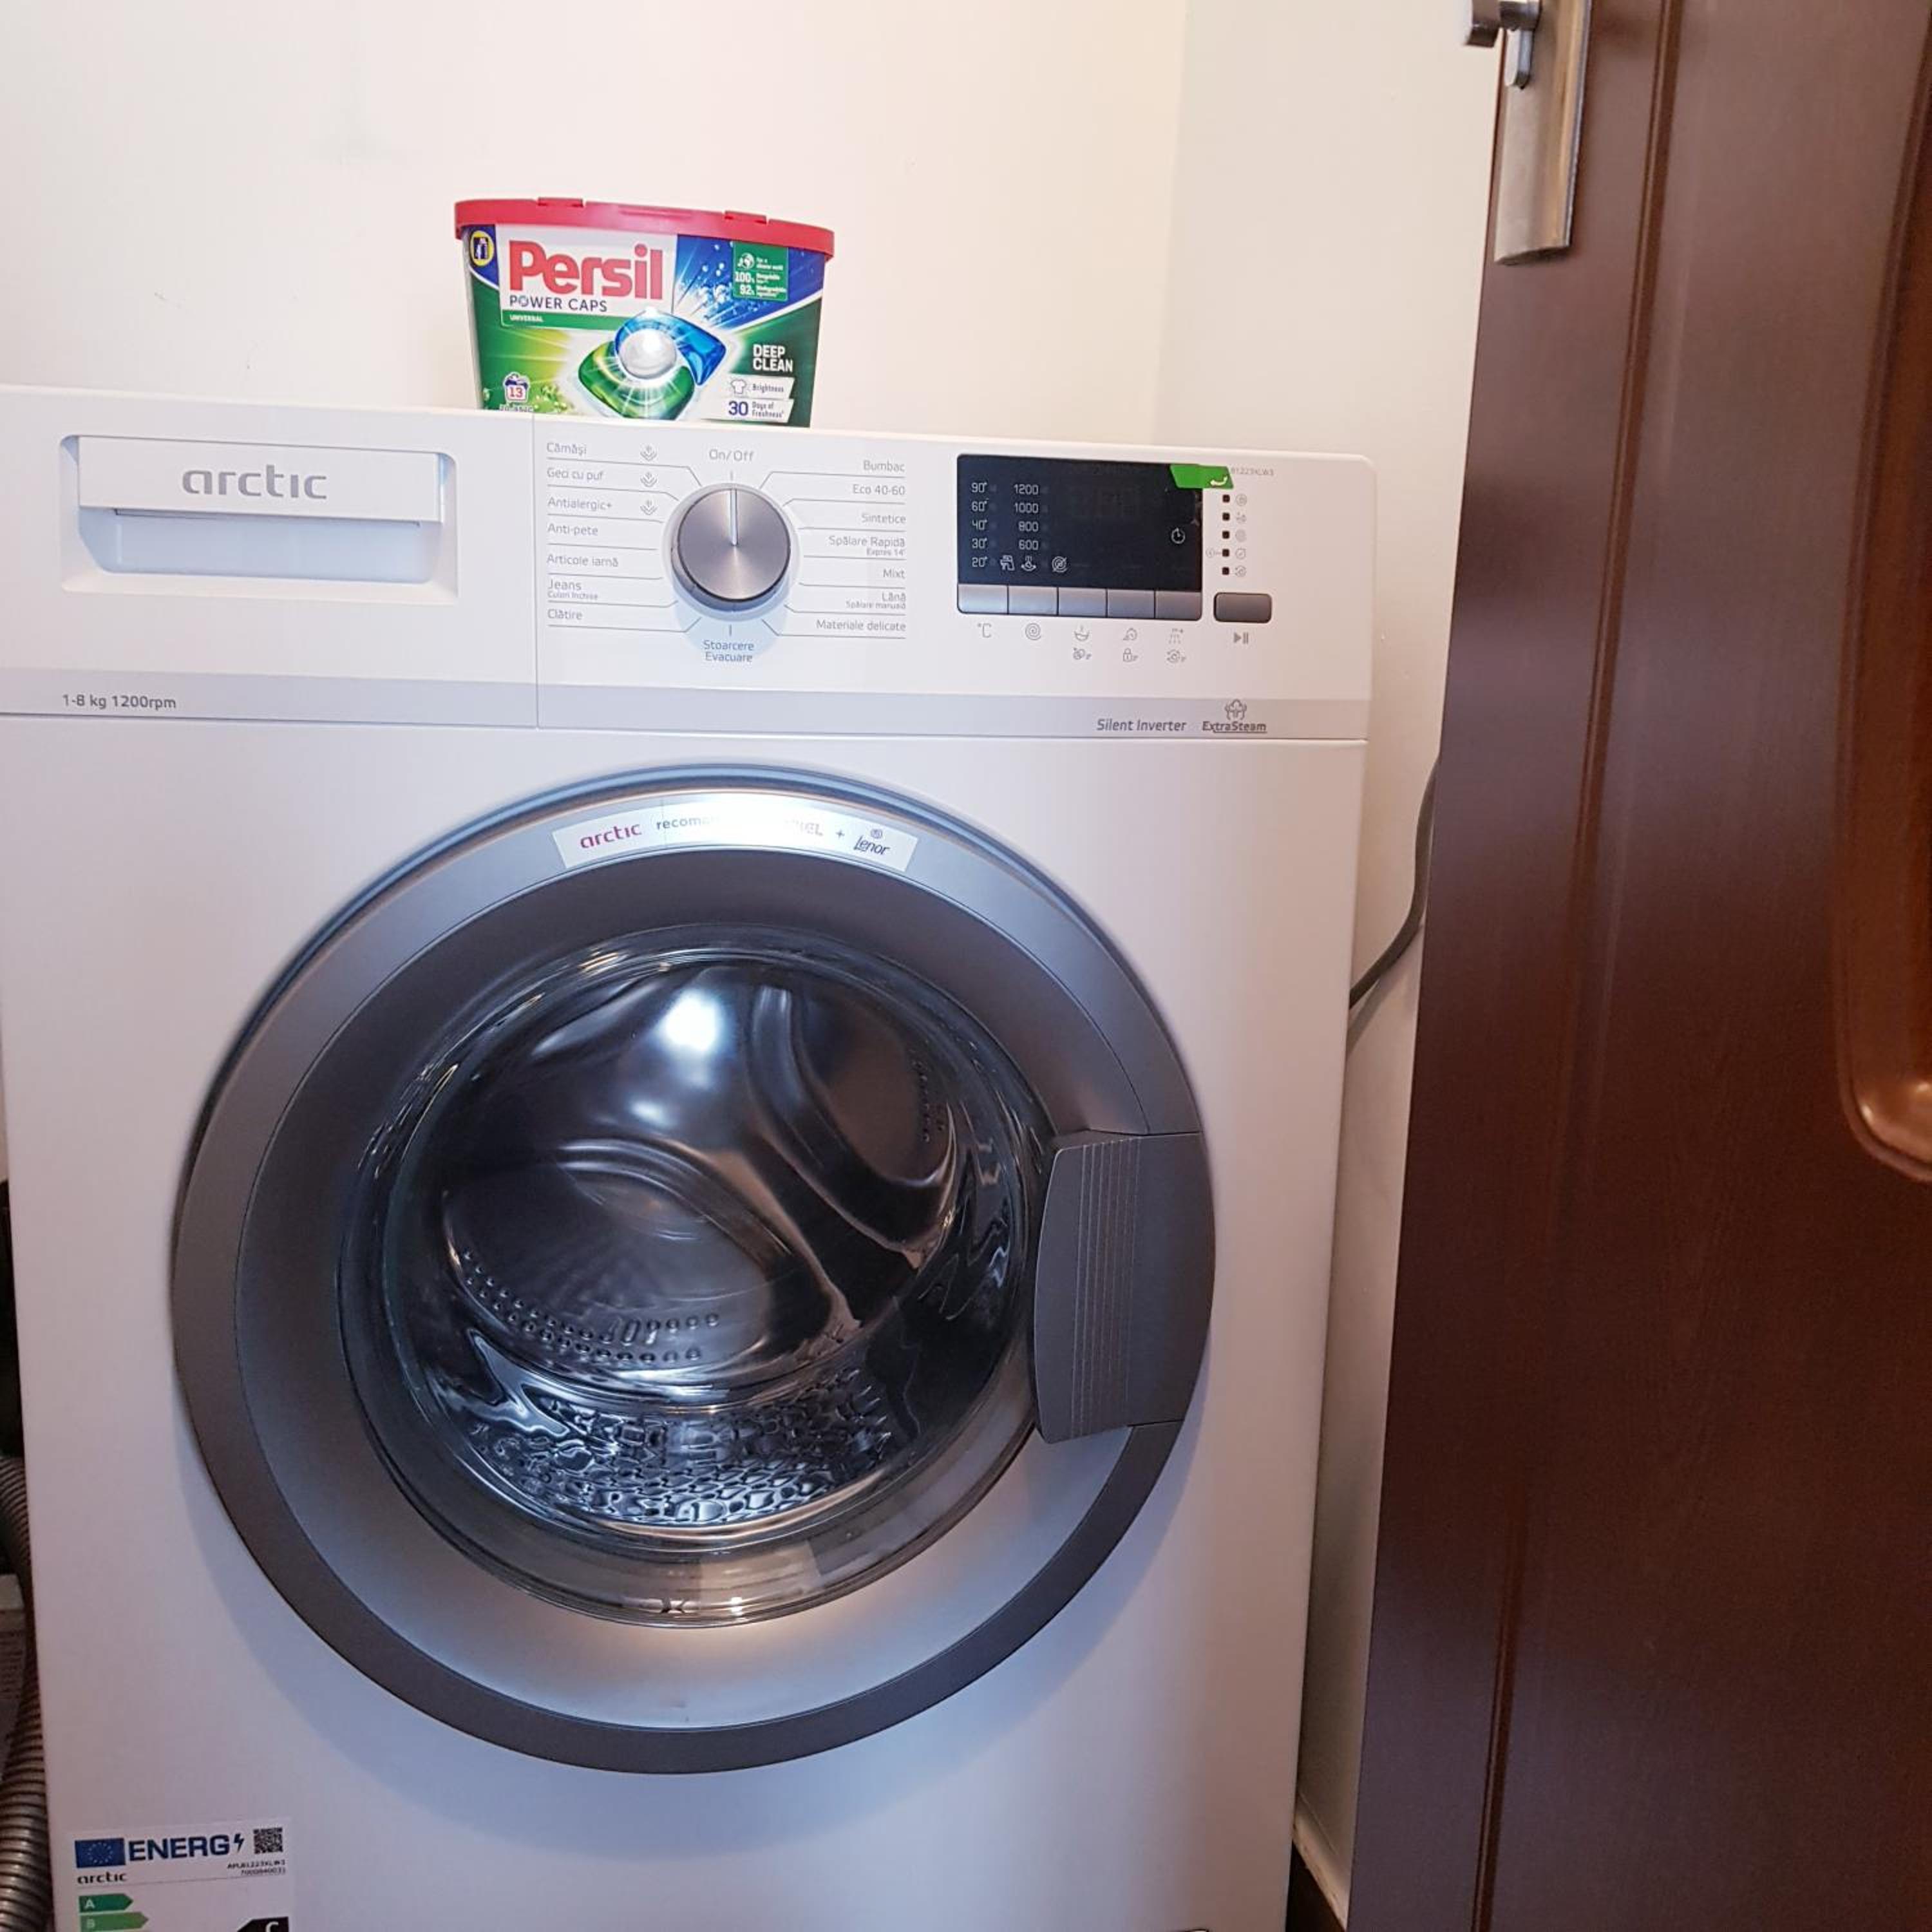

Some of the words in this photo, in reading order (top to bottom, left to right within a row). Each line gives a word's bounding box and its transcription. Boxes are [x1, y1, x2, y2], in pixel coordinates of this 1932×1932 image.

[509, 240, 663, 300] Persil
[509, 295, 562, 309] POWER
[569, 298, 607, 312] CAPS
[753, 344, 785, 358] DEEP
[753, 358, 793, 372] CLEAN
[509, 387, 524, 397] 13
[752, 383, 784, 393] Brightness
[728, 400, 748, 416] 30
[863, 460, 905, 472] Bumbac
[182, 464, 327, 500] arctic
[547, 468, 569, 478] Geci
[572, 471, 584, 480] cu
[587, 469, 605, 484] puf
[853, 484, 871, 495] Eco
[875, 485, 905, 495] 40-60
[1014, 484, 1039, 495] 1200
[547, 496, 612, 512] Antialergic+
[1014, 502, 1039, 513] 1000
[861, 513, 906, 524] Sintetice
[547, 522, 598, 536] Anti-pete
[1018, 521, 1039, 532] 800
[1018, 540, 1039, 551] 600
[547, 554, 588, 566] Articole
[882, 568, 905, 578] Mixt
[547, 579, 582, 591] Jeans
[816, 618, 864, 630] Materiale
[867, 620, 906, 632] delicate
[703, 639, 754, 651] Stoarcere
[705, 651, 753, 662] Evacuare
[62, 694, 84, 707] 1-8
[90, 694, 106, 709] kg
[112, 694, 176, 710] 1200rpm
[1097, 719, 1134, 732] Silent
[1137, 719, 1186, 732] Inverter
[1202, 721, 1267, 732] ExtraSteam
[580, 823, 641, 849] arctic
[854, 834, 891, 855] Lenor
[128, 1834, 230, 1862] ENERG
[77, 1871, 128, 1885] arctic
[84, 1899, 95, 1909] A
[86, 1918, 95, 1928] B
